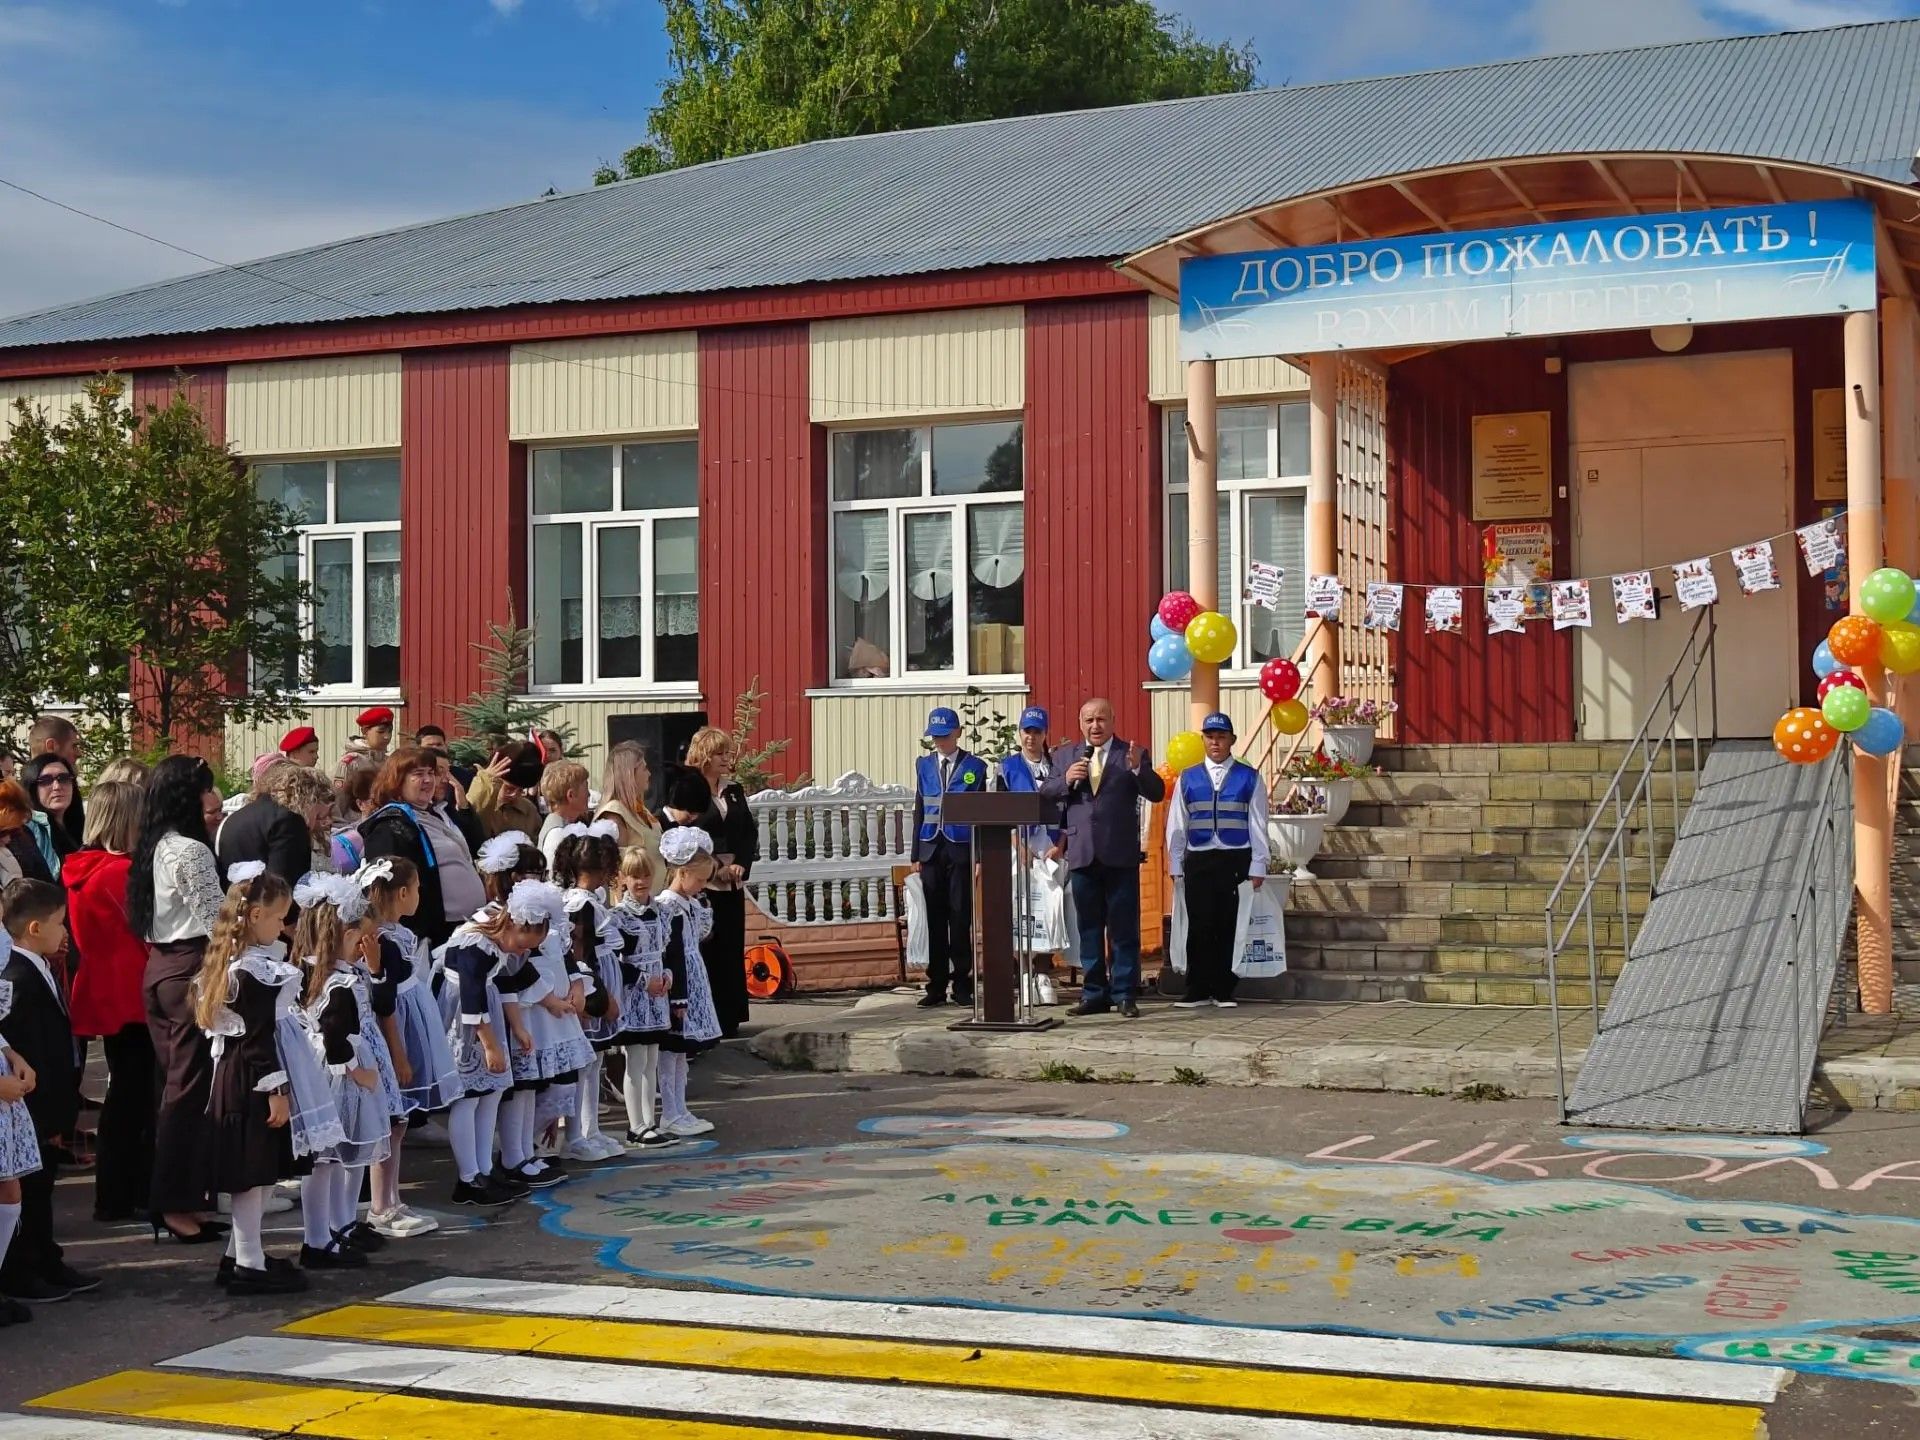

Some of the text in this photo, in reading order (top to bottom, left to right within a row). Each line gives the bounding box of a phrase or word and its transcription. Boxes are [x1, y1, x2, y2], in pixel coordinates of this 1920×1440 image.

[1232, 247, 1403, 301] ДОБРО
[1421, 214, 1790, 279] ПОЖАЛОВАТЬ
[1496, 525, 1545, 535] СЕНТЯБРЯ
[920, 1192, 1135, 1209] АЛИНА
[987, 1209, 1505, 1243] ВАЛЕРЬЕВНА
[1685, 1217, 1857, 1234] ЕВА
[1570, 1237, 1803, 1263] САЛАВАТ
[1434, 1275, 1699, 1326] МАРСЕЛЬ
